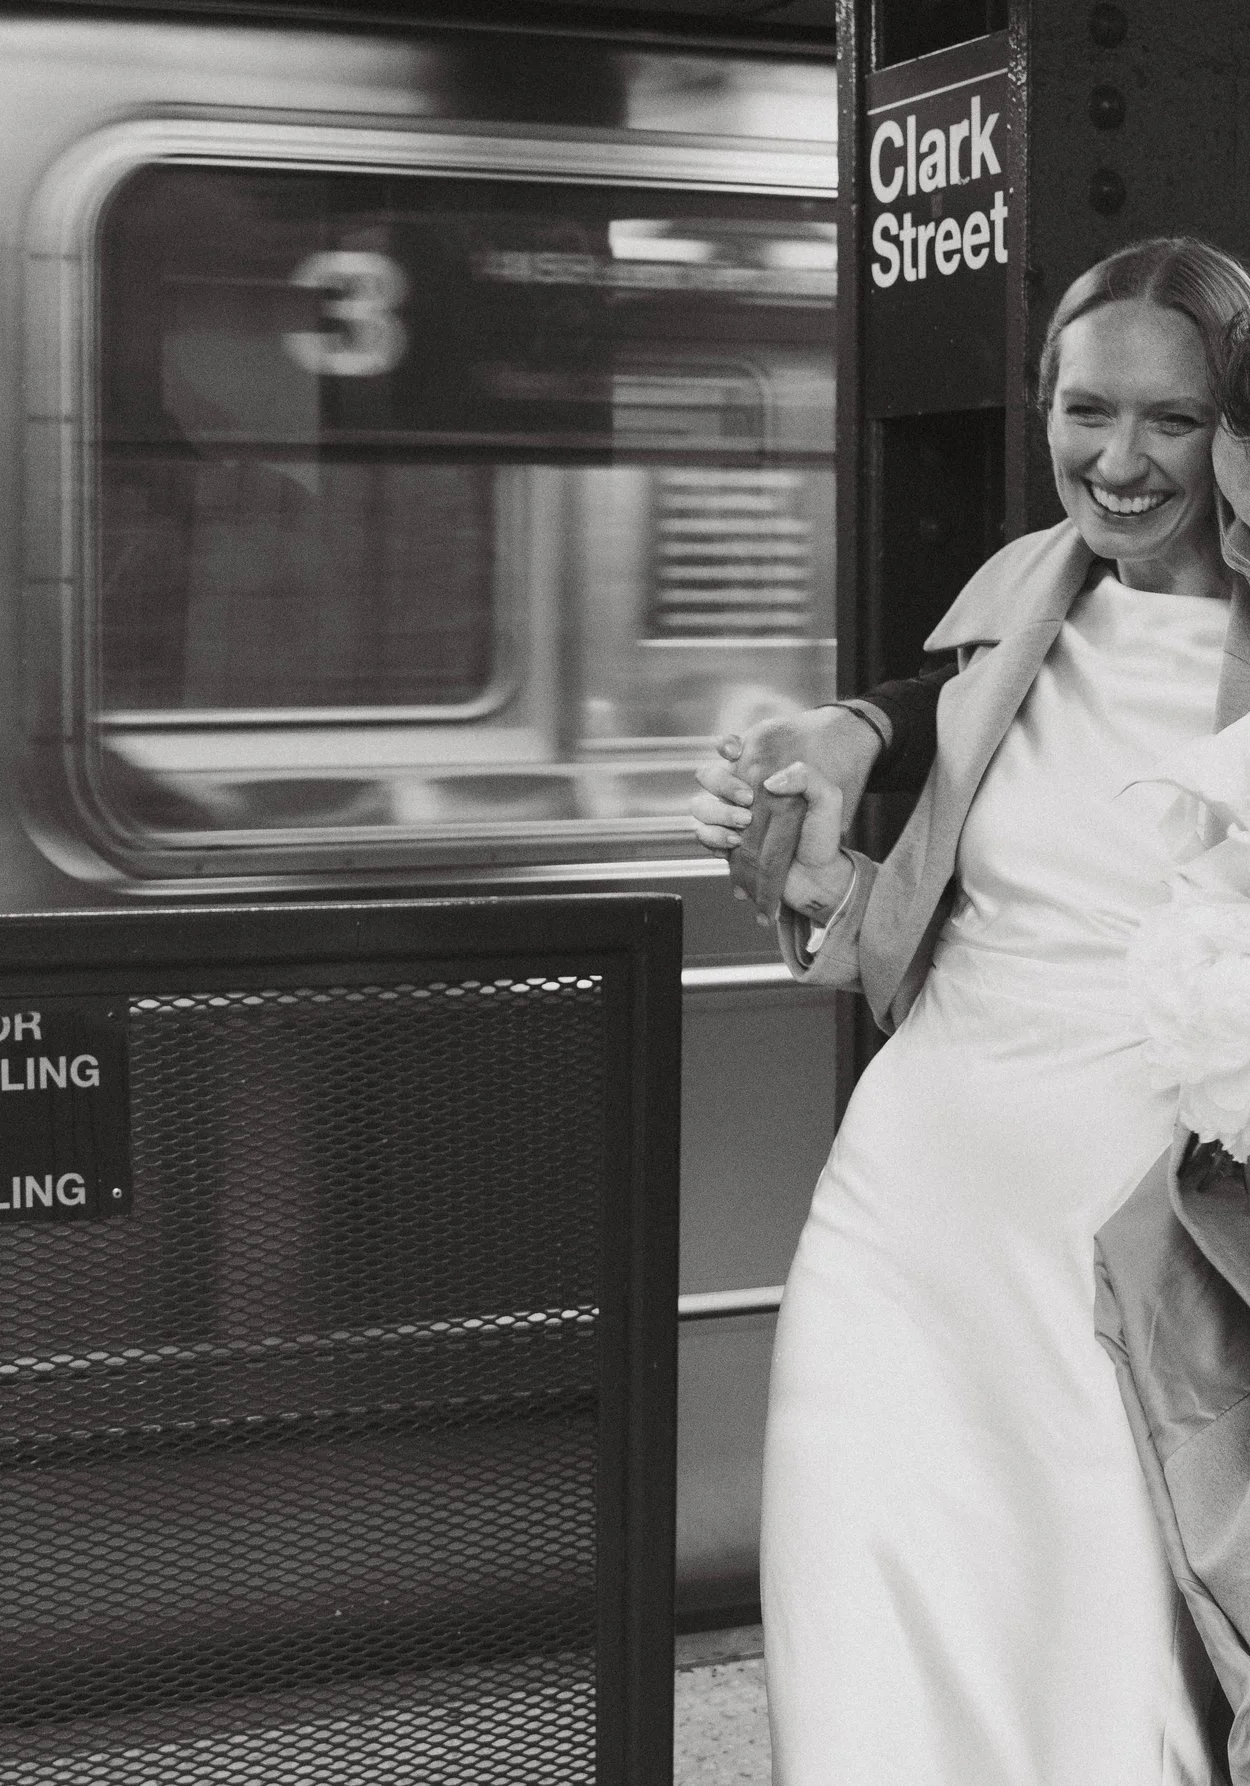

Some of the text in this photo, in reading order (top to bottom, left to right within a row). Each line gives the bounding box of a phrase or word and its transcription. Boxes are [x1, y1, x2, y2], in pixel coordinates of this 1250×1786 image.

[870, 95, 1002, 203] Clark
[871, 190, 1008, 288] Street
[284, 251, 409, 377] 3
[0, 1054, 100, 1091] LING
